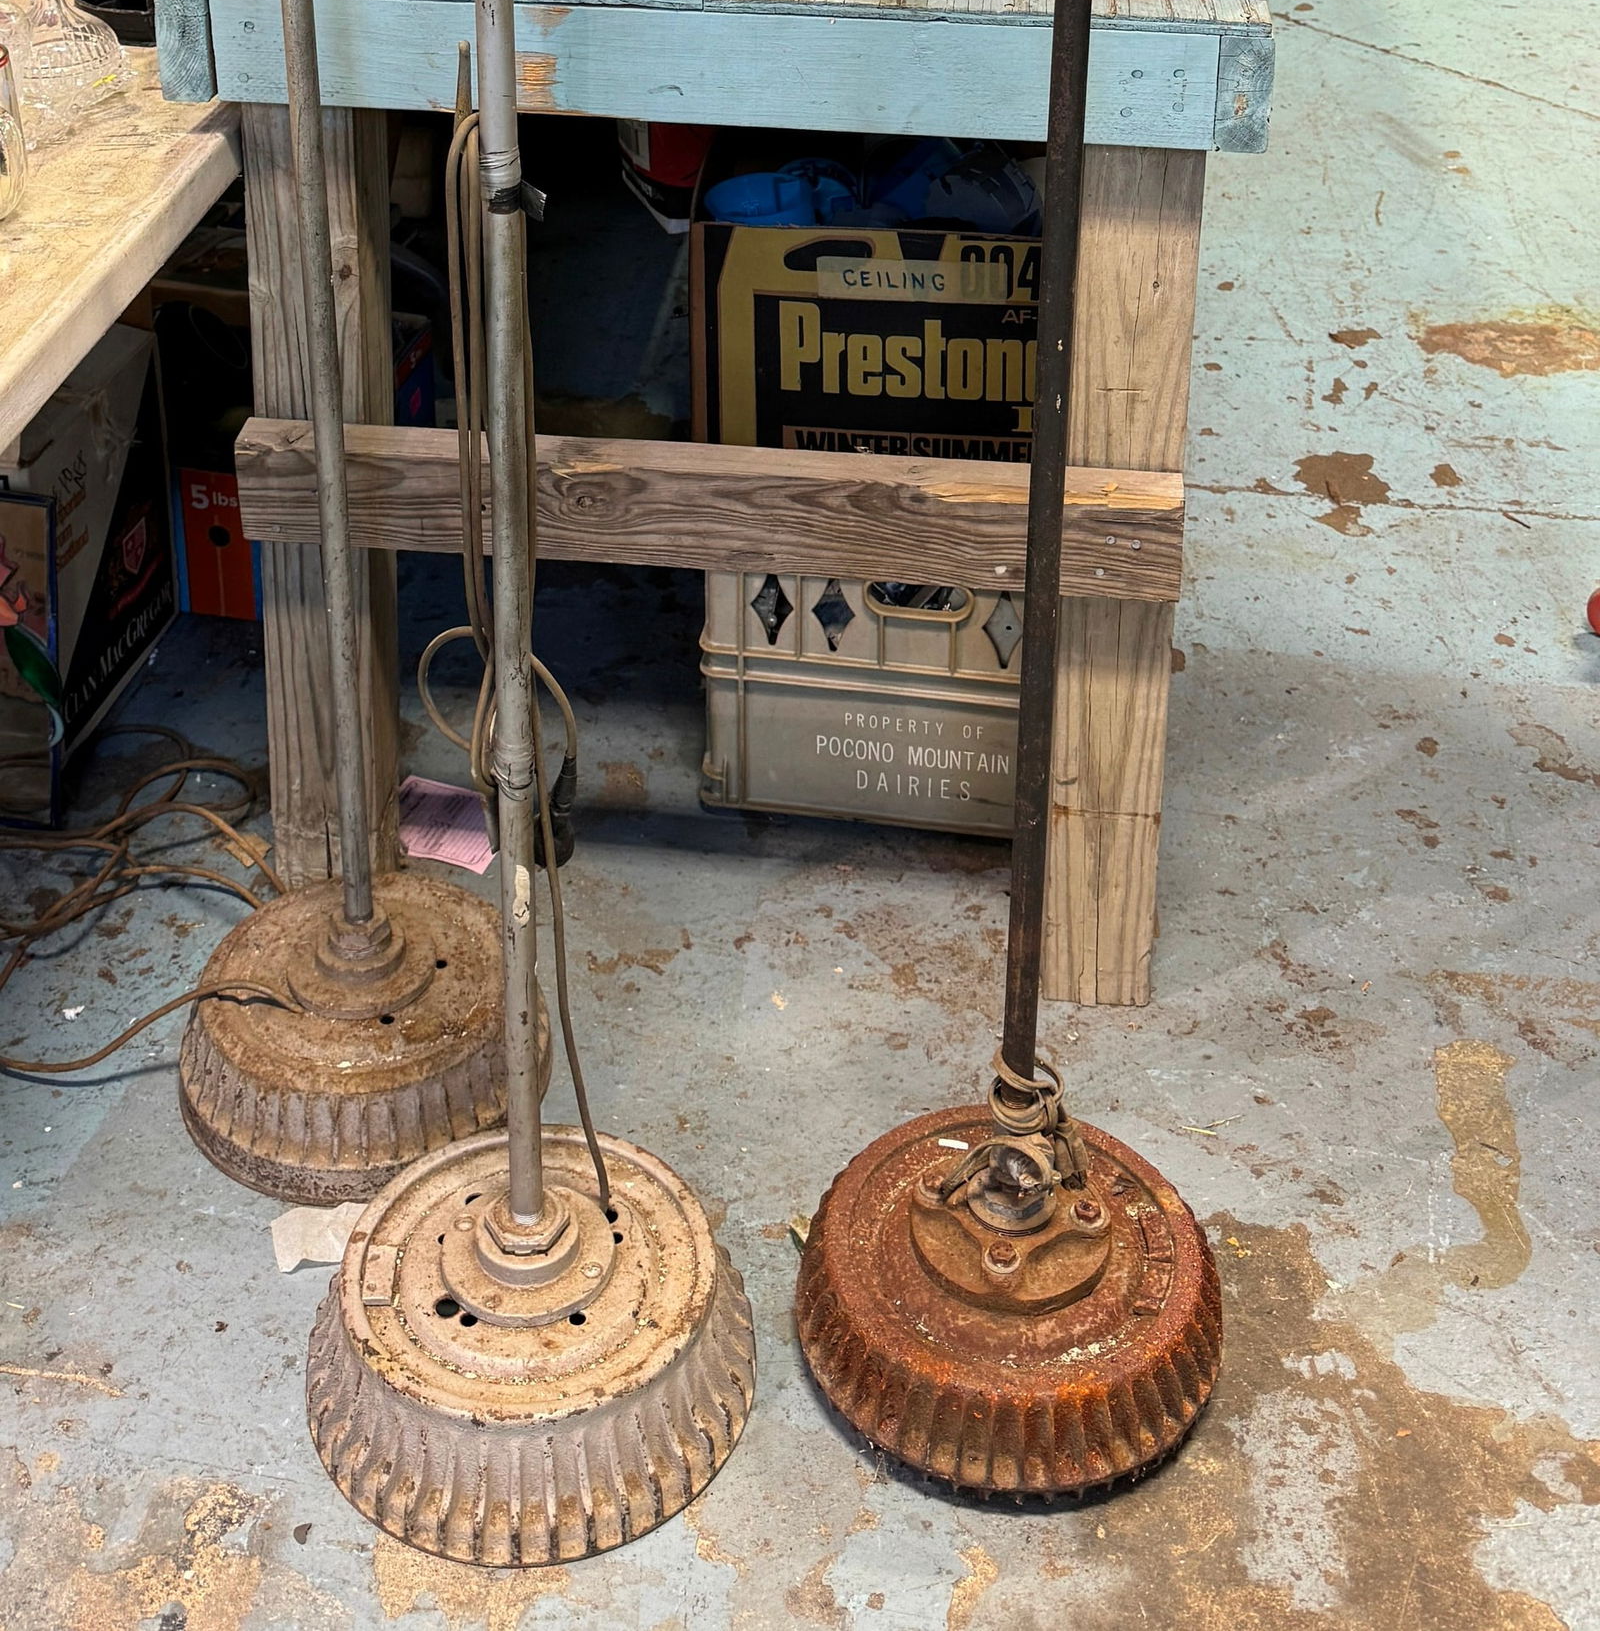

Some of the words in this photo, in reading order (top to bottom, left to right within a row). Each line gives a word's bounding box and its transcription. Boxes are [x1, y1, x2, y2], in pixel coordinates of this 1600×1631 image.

[842, 269, 945, 291] CEILING
[913, 436, 1031, 462] SUMME
[191, 484, 209, 509] 5
[212, 491, 238, 507] lbs
[844, 712, 944, 736] PROPERTY
[962, 724, 984, 740] OF
[816, 735, 894, 763] POCONO
[907, 745, 1010, 775] MOUNTAIN
[856, 769, 971, 801] DAIRIES
